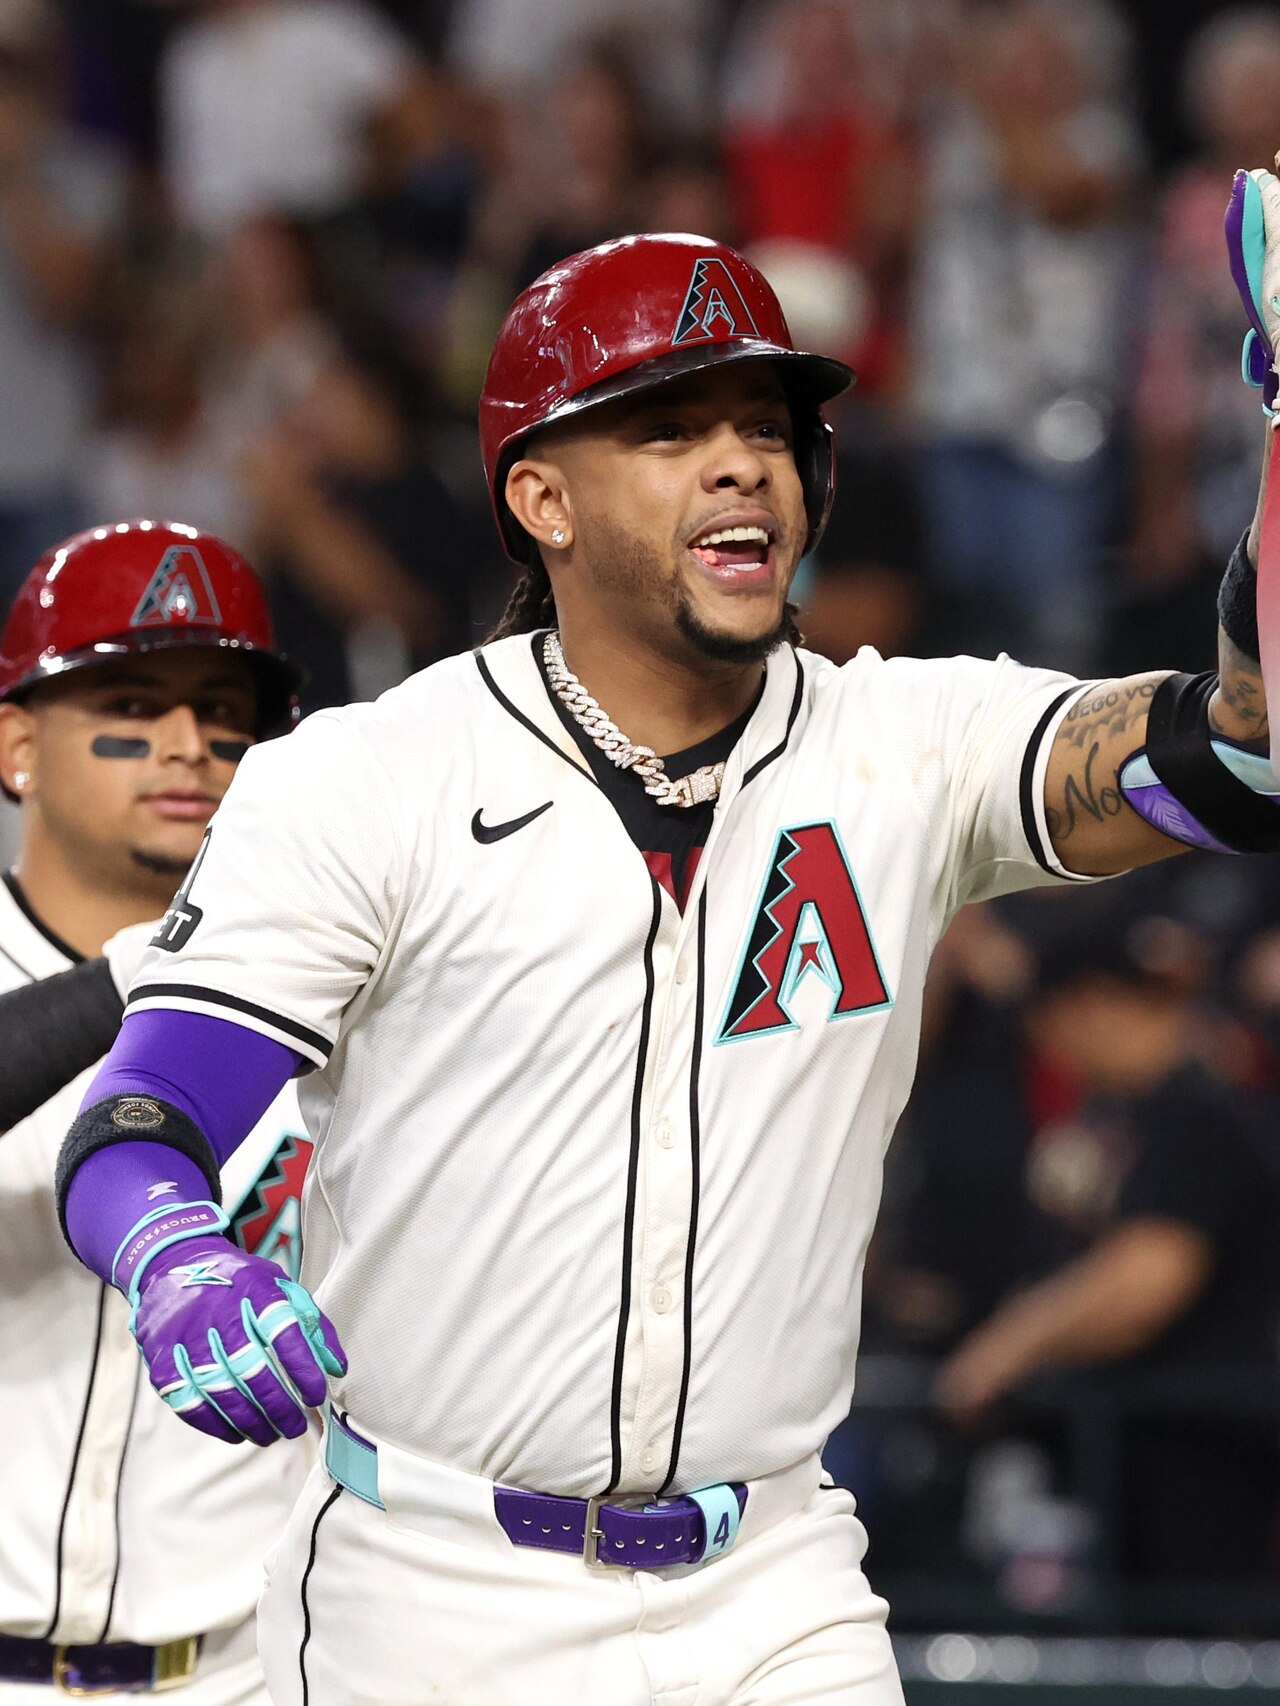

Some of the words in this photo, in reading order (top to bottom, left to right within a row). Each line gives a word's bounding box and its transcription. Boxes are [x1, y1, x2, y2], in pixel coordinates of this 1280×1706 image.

[672, 258, 760, 345] A
[712, 817, 894, 1046] A
[712, 1512, 730, 1548] 4
